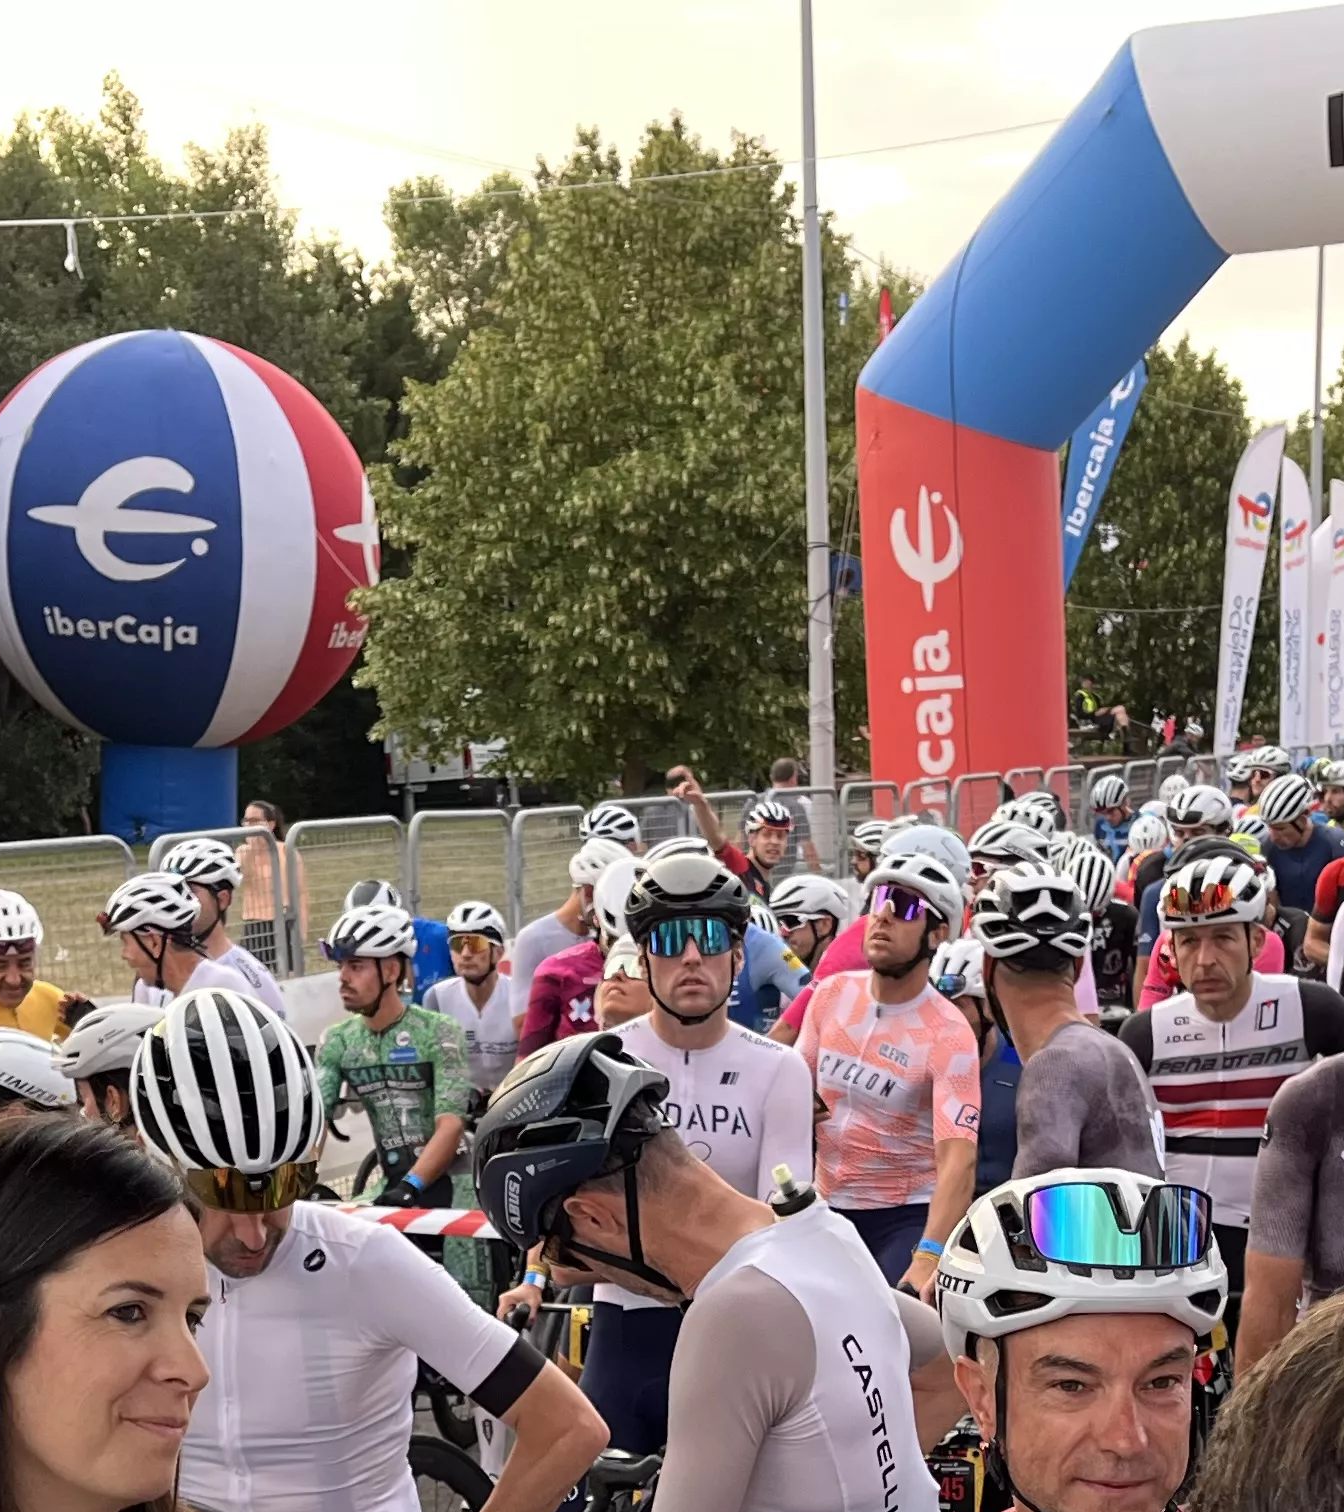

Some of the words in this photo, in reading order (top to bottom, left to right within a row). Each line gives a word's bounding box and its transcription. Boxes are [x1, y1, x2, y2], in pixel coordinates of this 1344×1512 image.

[1064, 415, 1117, 538] Ibercaja
[42, 606, 198, 652] iberCaja
[900, 628, 965, 826] rcaja
[819, 1054, 897, 1098] CYCLON
[665, 1102, 753, 1139] DAPA
[505, 1180, 522, 1229] ABUS
[937, 1269, 975, 1294] COTT
[941, 1476, 966, 1502] 45
